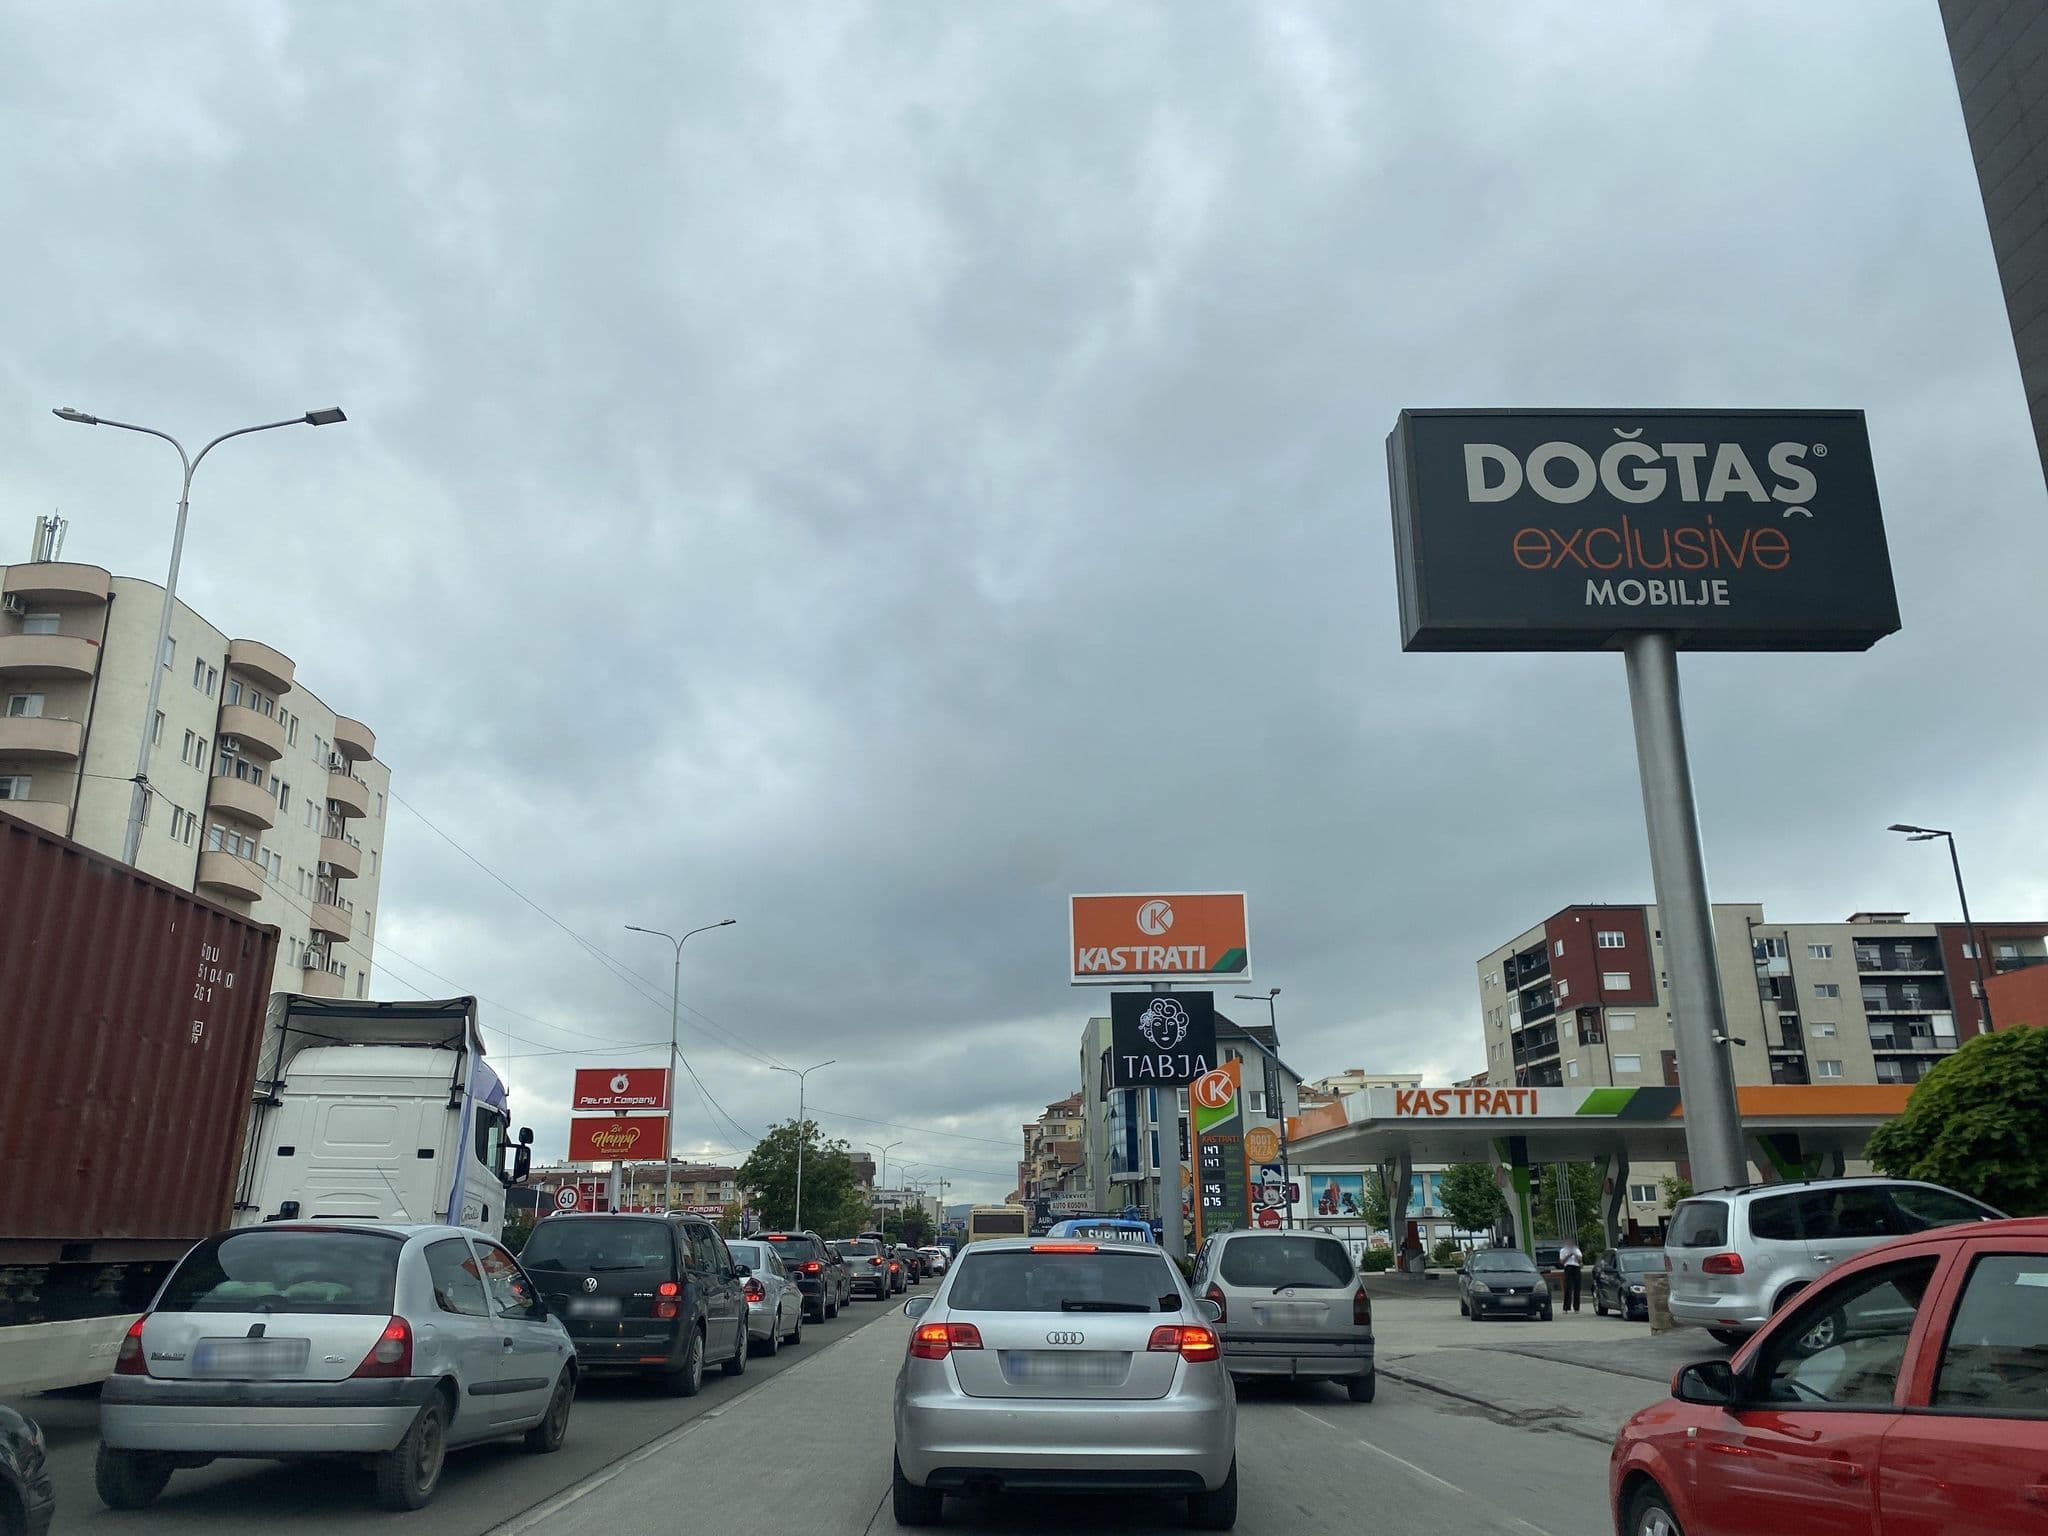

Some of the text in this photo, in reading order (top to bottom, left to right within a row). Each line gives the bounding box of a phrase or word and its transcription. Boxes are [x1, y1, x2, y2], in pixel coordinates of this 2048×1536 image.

[1513, 514, 1790, 570] exclusive
[1585, 578, 1731, 606] MOBILJE
[1078, 945, 1206, 972] KASTRATI
[1122, 1054, 1210, 1079] TABJA
[580, 1096, 656, 1105] Petrol Company
[1396, 1089, 1538, 1116] KASTRATI
[591, 1127, 640, 1148] Happy
[1201, 1135, 1240, 1143] KASTRATI
[560, 1192, 574, 1204] 60
